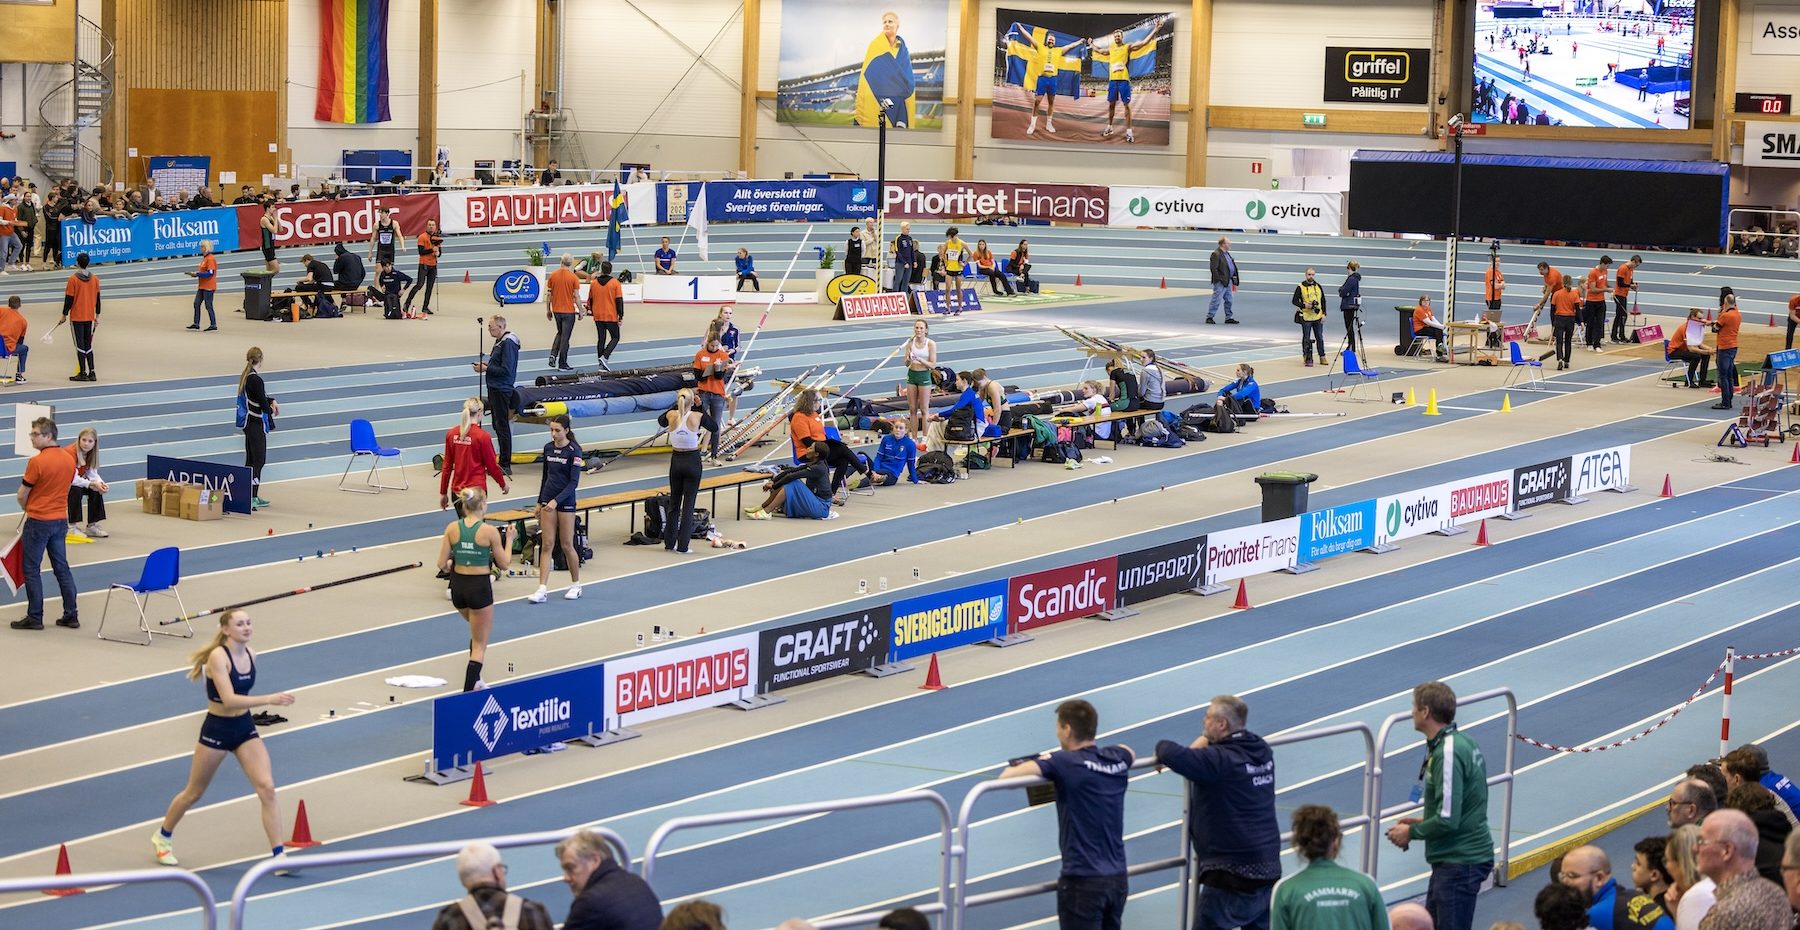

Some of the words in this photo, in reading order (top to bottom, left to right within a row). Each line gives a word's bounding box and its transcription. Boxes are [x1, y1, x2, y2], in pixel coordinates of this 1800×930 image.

[1762, 21, 1800, 39] Ass
[1352, 58, 1401, 77] griffel
[1352, 86, 1388, 100] Pålitlig
[1390, 88, 1401, 98] IT
[1762, 100, 1782, 113] 0.0
[1762, 133, 1800, 154] SM
[733, 188, 752, 199] Allt
[754, 187, 802, 199] överskott
[802, 188, 817, 199] till
[883, 185, 1008, 215] Prioritet
[1014, 189, 1105, 219] Finans
[468, 193, 620, 225] BAUHAU
[670, 205, 685, 214] 2021
[725, 201, 768, 213] Sveriges
[769, 201, 824, 213] föreningar.
[846, 204, 875, 213] folkspel
[1155, 198, 1204, 214] cytiva
[1271, 203, 1320, 218] cytiva
[65, 223, 132, 248] Folksam
[153, 215, 219, 240] Folksam
[688, 276, 699, 300] 1
[778, 293, 785, 303] 3
[845, 296, 907, 316] BAUHAUS
[1518, 465, 1558, 495] CRAFT
[1577, 450, 1623, 492] ATEA
[1451, 480, 1508, 516] BAUHAUS
[1404, 496, 1438, 527] cytiva
[1311, 508, 1363, 542] Folksam
[1208, 539, 1260, 571] Prioritet
[1261, 535, 1297, 560] Finans
[1118, 554, 1194, 592] UNISPORT
[1018, 568, 1107, 623] Scandic
[894, 597, 989, 647] SVERIGELOTTEN
[773, 620, 859, 667] CRAFT
[618, 651, 748, 710] BAUHAUS
[772, 668, 810, 684] FUNCTIONAL
[810, 658, 850, 675] SPORTSWEAR
[510, 697, 571, 732] Textilia
